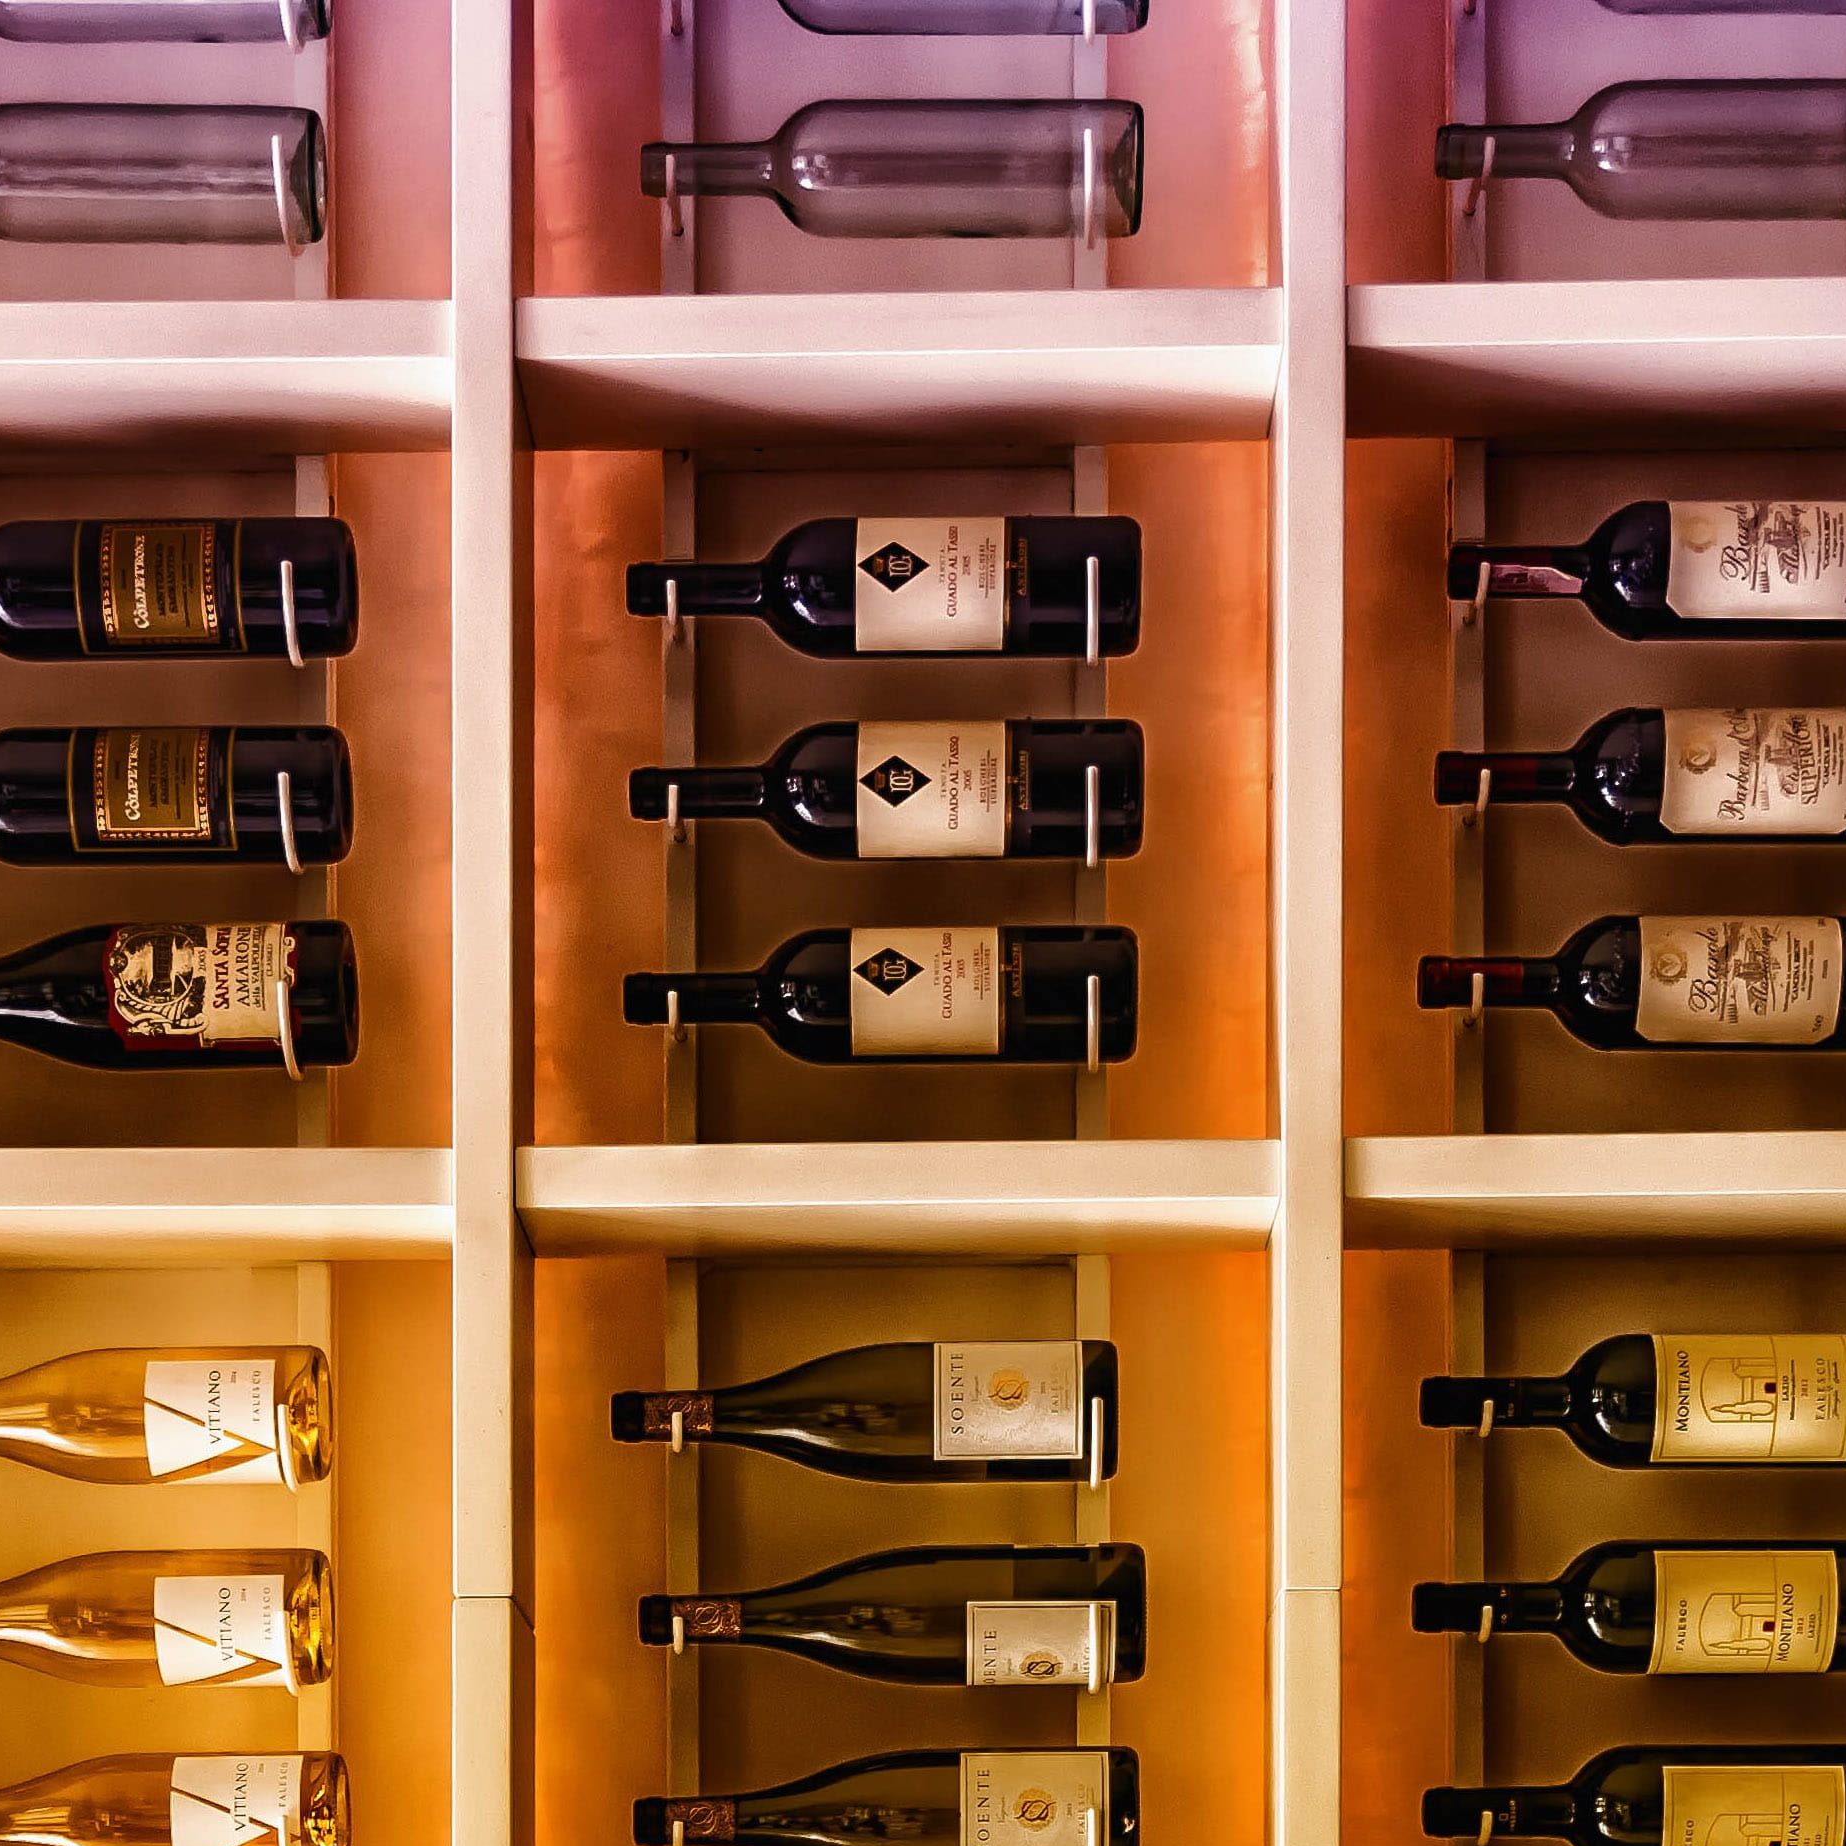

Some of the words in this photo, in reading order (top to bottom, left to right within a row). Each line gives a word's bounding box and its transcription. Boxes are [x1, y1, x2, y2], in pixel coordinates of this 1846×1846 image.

[948, 526, 958, 552] TASSO
[948, 556, 958, 569] AL
[947, 572, 958, 617] GUADO
[949, 736, 959, 767] TASSO
[949, 770, 958, 785] AL
[1717, 749, 1747, 820] Barbera
[948, 789, 959, 830] GUADO
[235, 927, 251, 1007] AMARONE
[942, 960, 952, 973] AL
[943, 933, 952, 957] TASSO
[1689, 927, 1719, 1012] Barolo
[213, 960, 230, 1009] SANTA
[253, 987, 261, 1008] della
[942, 977, 952, 1019] GUADO
[208, 1371, 222, 1444] VITIANO
[252, 1371, 261, 1422] FALESCO
[951, 1352, 964, 1434] SOENTE
[1676, 1351, 1690, 1431] MONTIANO
[1815, 1358, 1827, 1420] FALESCO
[218, 1587, 234, 1661] VITIANO
[263, 1587, 272, 1640] FALESCO
[1676, 1600, 1687, 1650] FALESCO
[1777, 1583, 1794, 1662] MONTIANO
[234, 1763, 248, 1831] VITIANO
[278, 1763, 288, 1807] FALESCO
